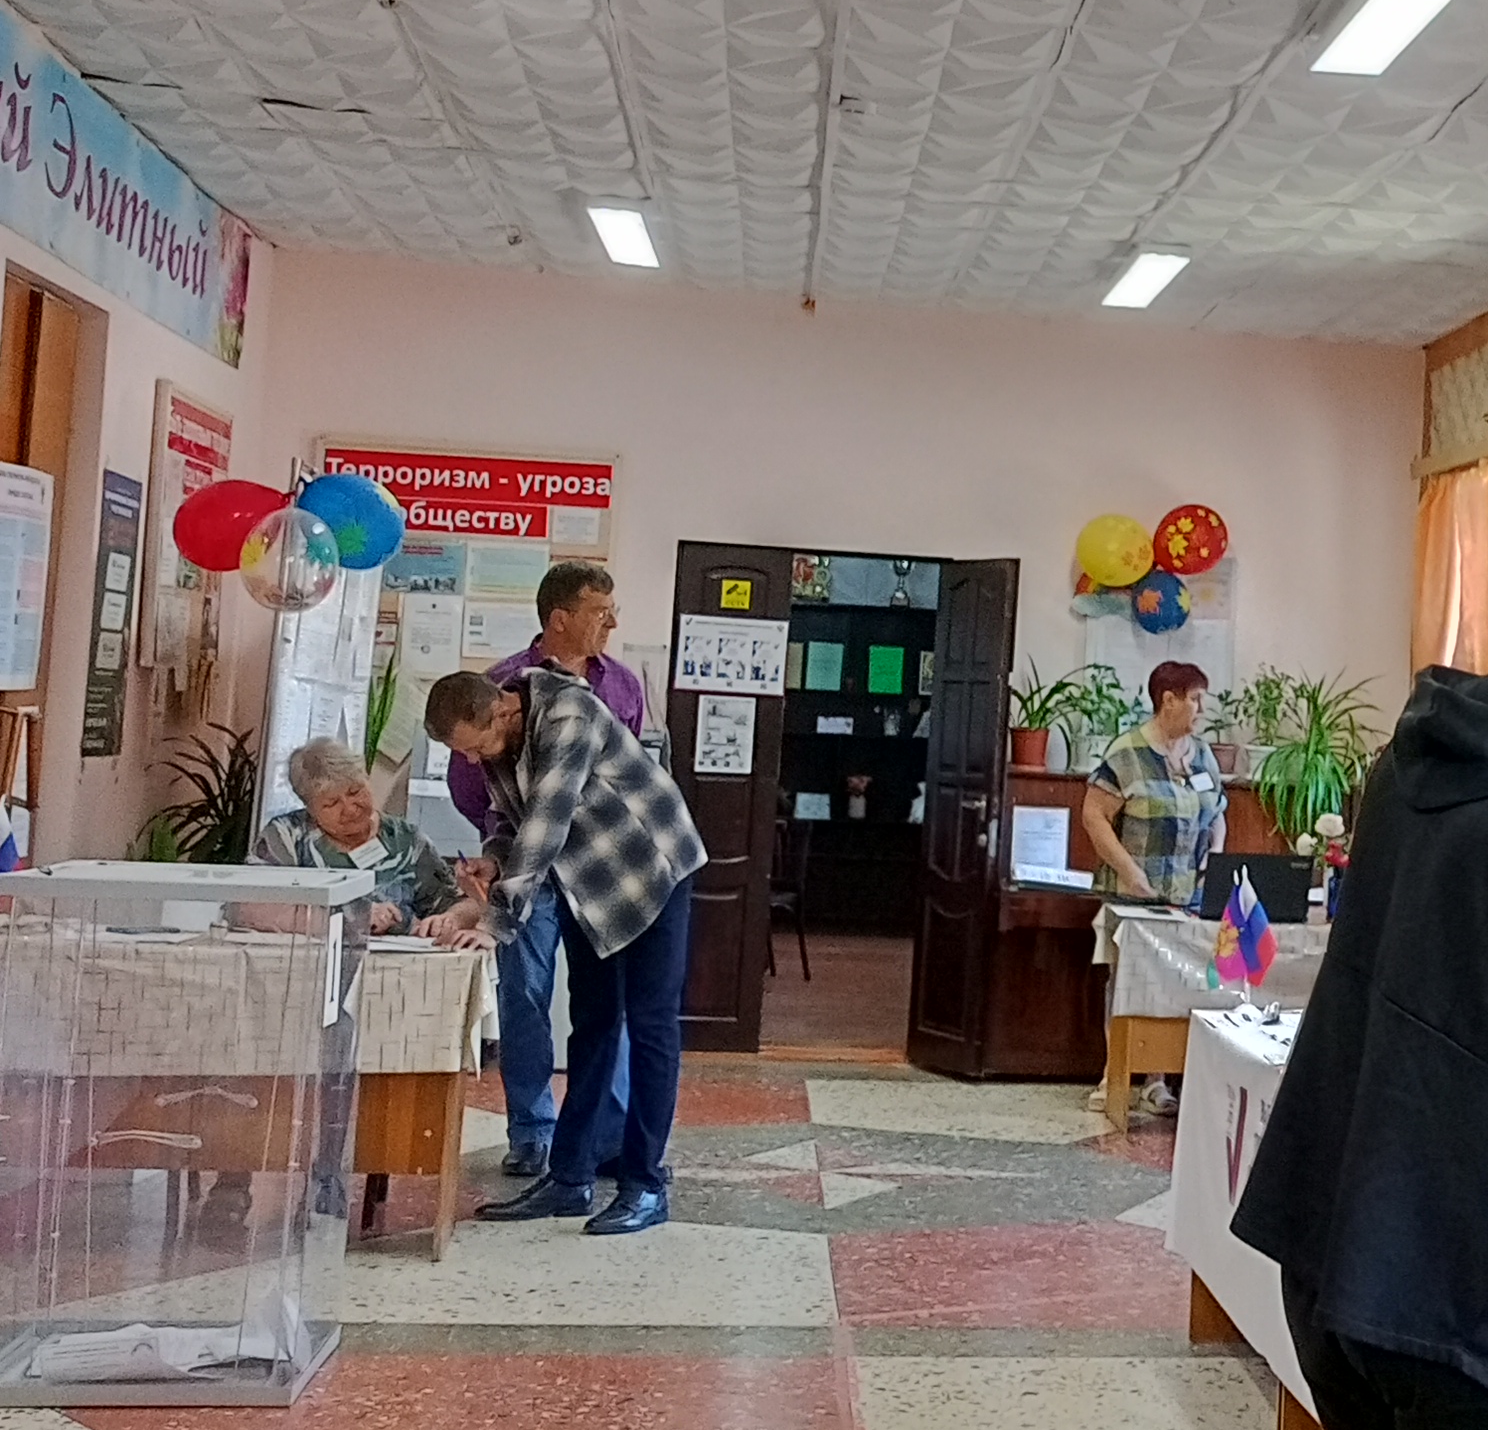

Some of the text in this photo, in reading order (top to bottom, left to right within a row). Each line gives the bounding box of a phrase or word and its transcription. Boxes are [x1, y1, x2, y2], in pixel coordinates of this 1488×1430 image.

[0, 62, 208, 299] й Элитный
[517, 472, 611, 497] угроза
